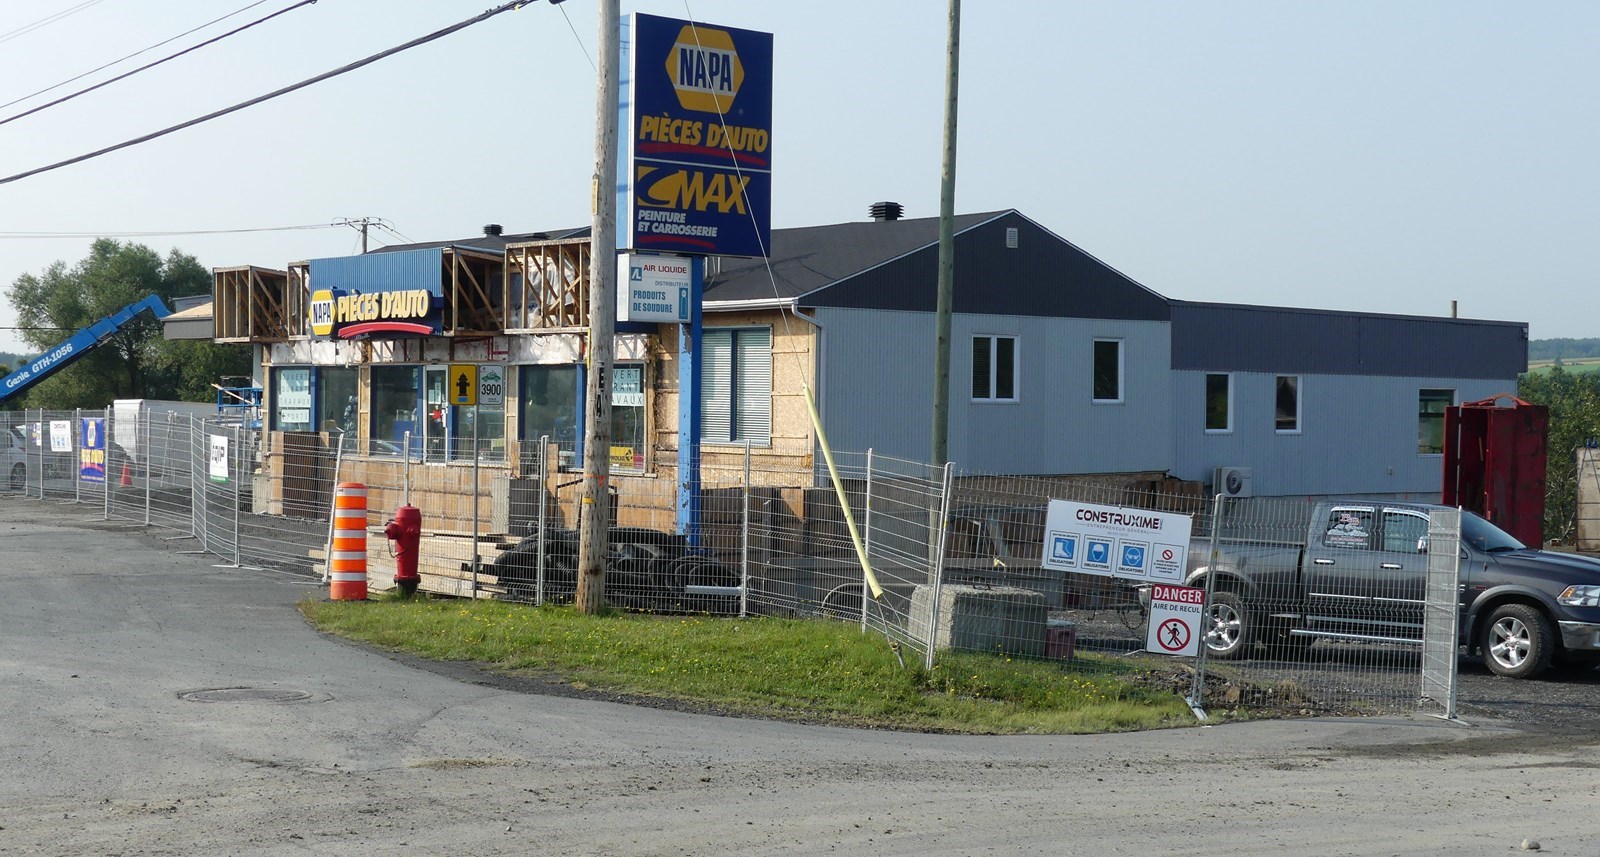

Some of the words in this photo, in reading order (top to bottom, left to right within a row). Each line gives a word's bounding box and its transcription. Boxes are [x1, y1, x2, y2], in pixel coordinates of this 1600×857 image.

[680, 48, 732, 91] NAPA
[639, 112, 703, 146] PIÈCES
[706, 123, 769, 153] D'AUTO
[638, 209, 687, 224] PEINTURE
[637, 221, 650, 232] ET
[652, 223, 718, 237] CARROSSERIE
[643, 264, 656, 272] AIR
[658, 265, 687, 274] LIQUIDE
[654, 280, 689, 288] DISTRIBUTEUR
[633, 290, 666, 301] PRODUITS
[381, 289, 429, 319] D'AUTO
[632, 302, 641, 312] DE
[642, 303, 673, 314] SOUDURE
[313, 302, 331, 324] NAPA
[6, 371, 30, 388] Genie
[32, 343, 73, 373] GTH-1056
[613, 370, 639, 379] VERT
[481, 383, 502, 396] 3900
[613, 383, 639, 392] RANT
[1076, 509, 1160, 530] CONSTRUXIME
[1154, 586, 1202, 603] DANGER
[1153, 602, 1168, 611] AIRE
[1169, 604, 1178, 612] DE
[1179, 605, 1200, 614] RECUL
